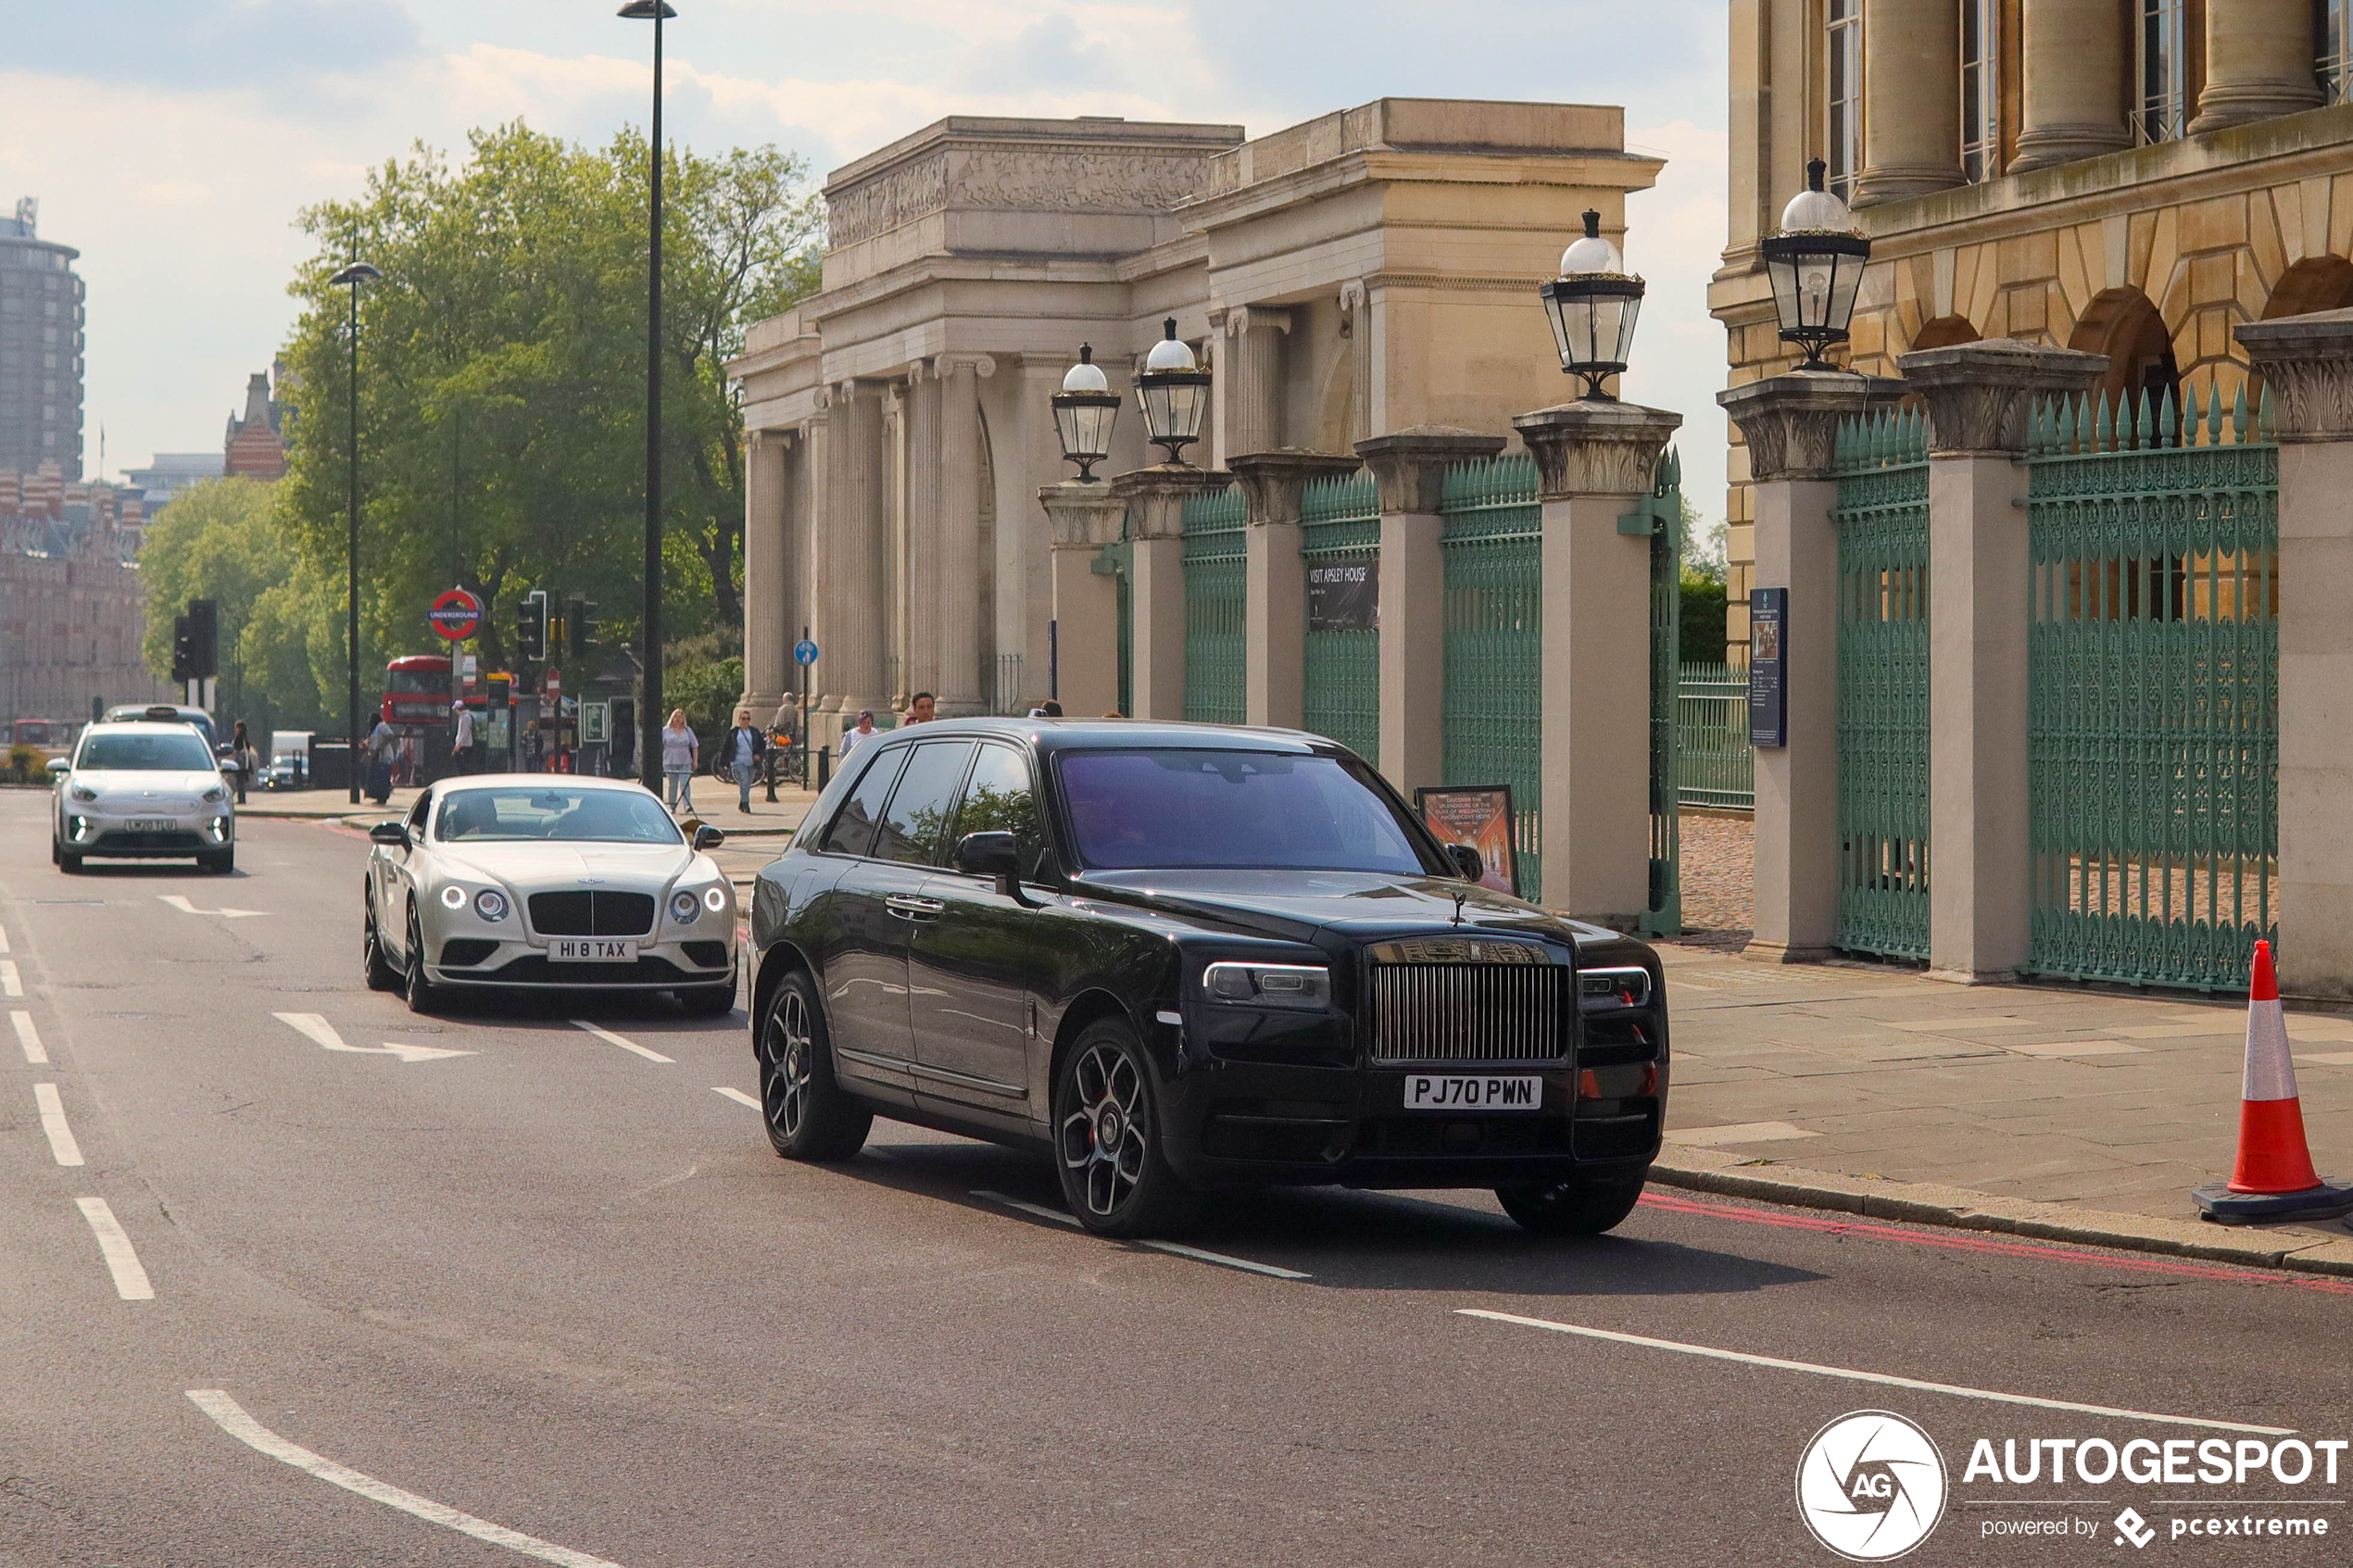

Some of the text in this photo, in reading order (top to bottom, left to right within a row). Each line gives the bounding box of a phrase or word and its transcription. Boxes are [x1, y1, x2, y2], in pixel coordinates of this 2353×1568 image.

[1309, 567, 1365, 583] VISIT APSLEY HOUSE
[596, 943, 625, 957] TAX
[1415, 1079, 1531, 1103] PJ70 PWN
